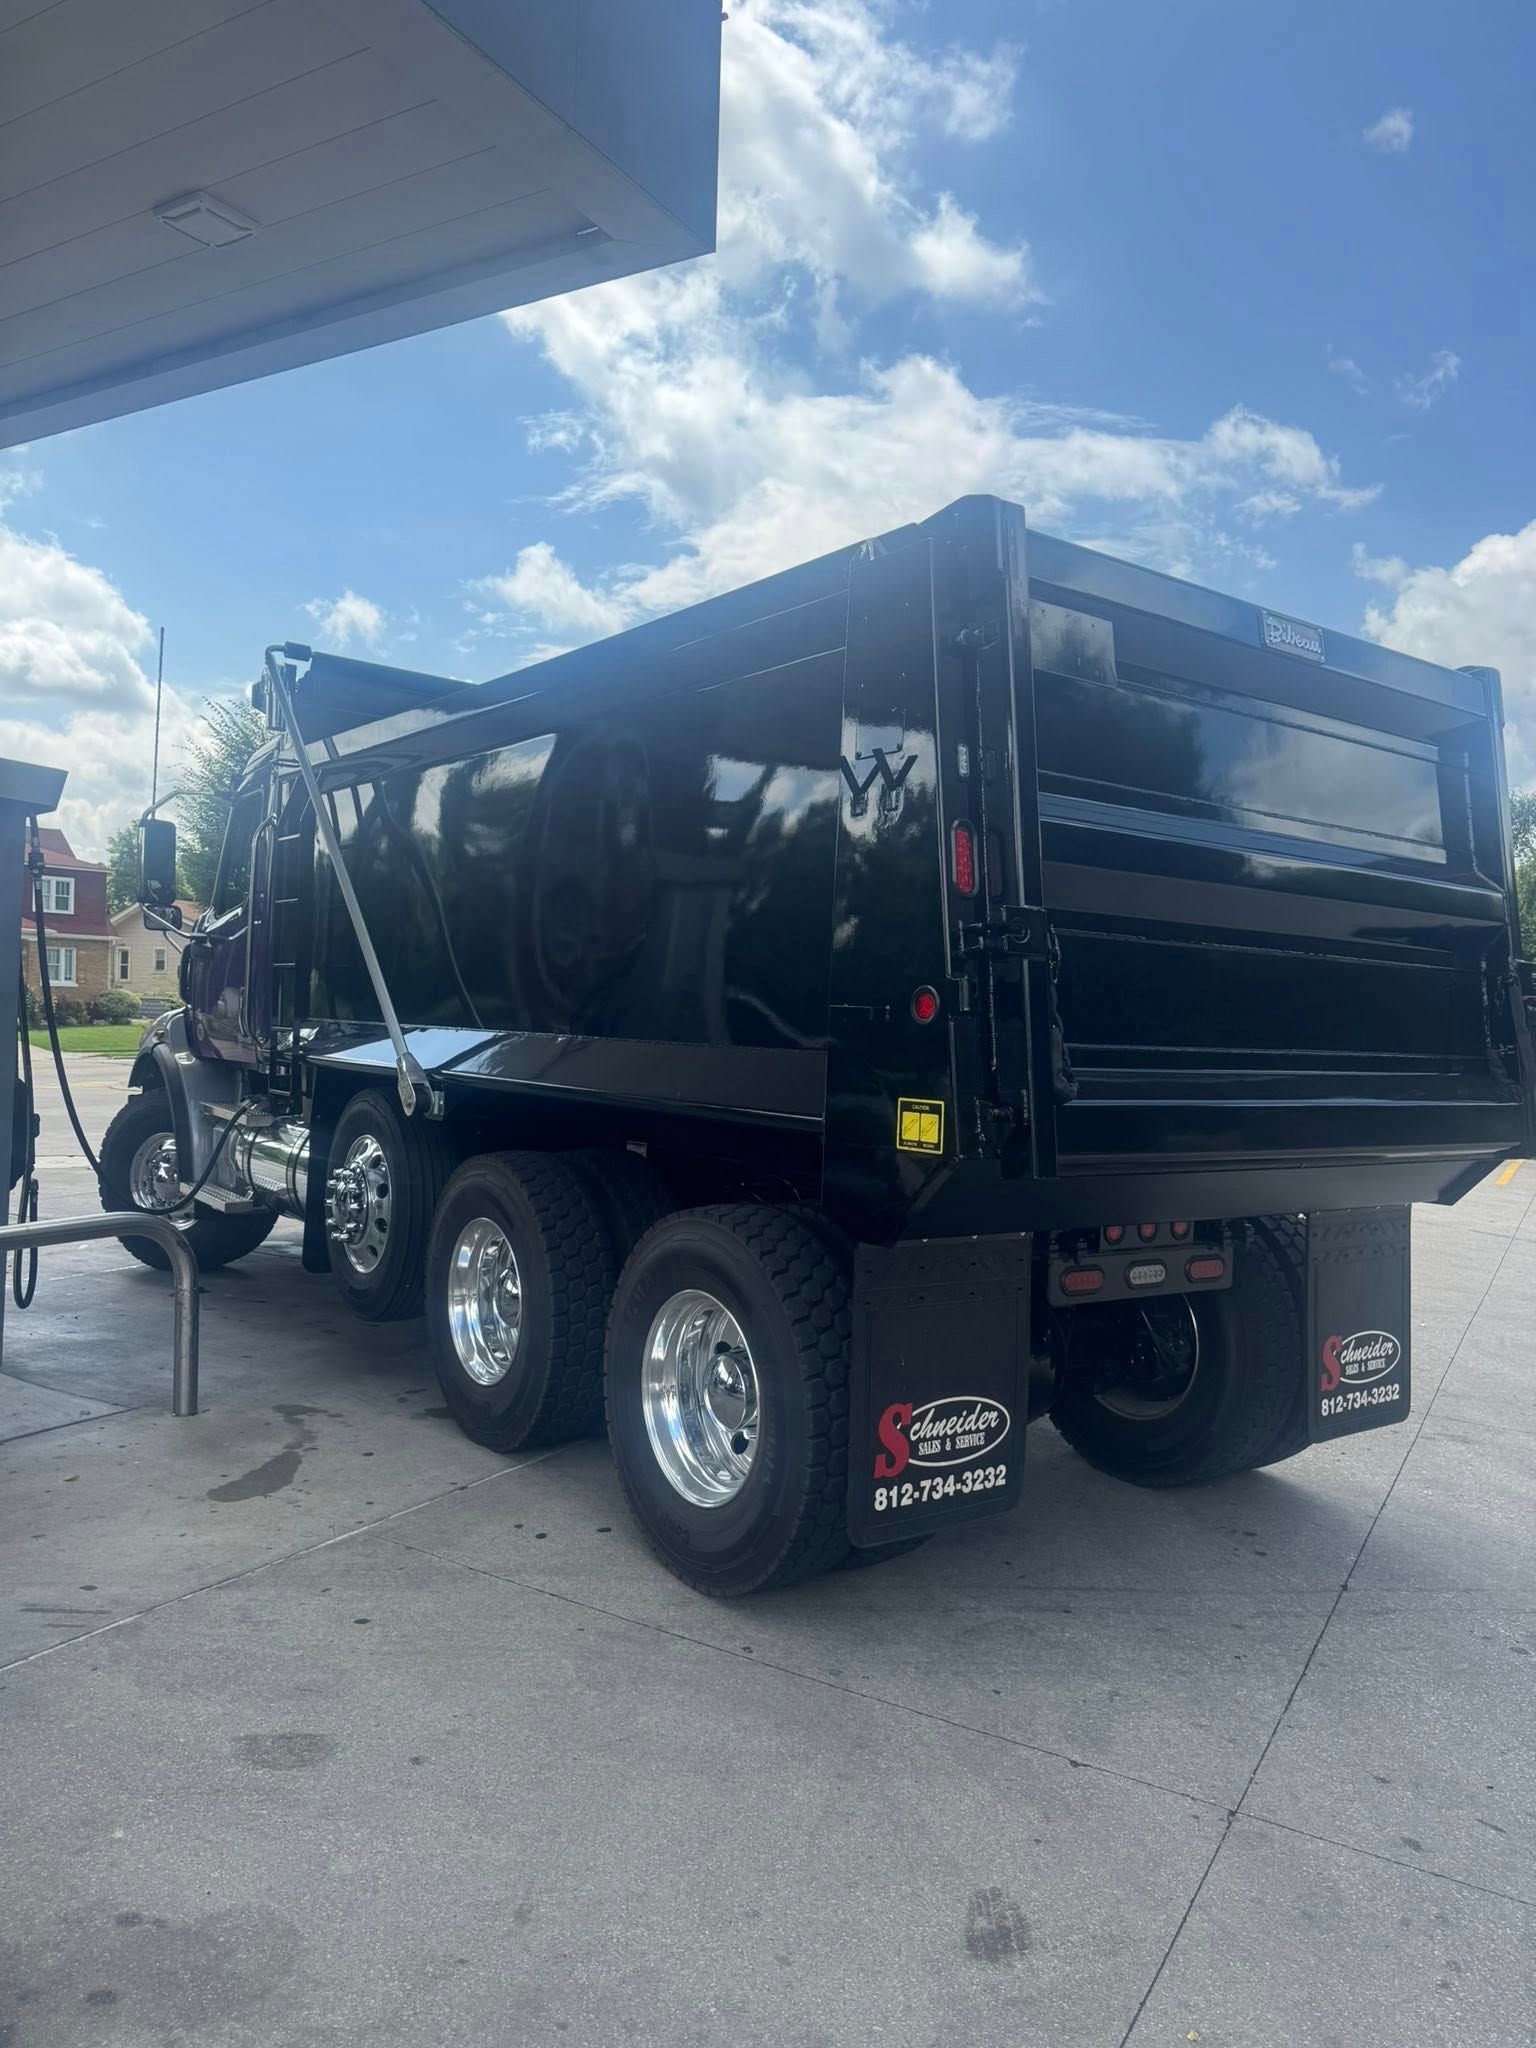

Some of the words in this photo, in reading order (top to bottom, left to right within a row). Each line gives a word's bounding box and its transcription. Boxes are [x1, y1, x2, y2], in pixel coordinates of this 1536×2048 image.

[1320, 1334, 1394, 1392] Schneider
[1321, 1383, 1400, 1416] 812-734-3232
[874, 1402, 999, 1478] Schneider
[918, 1439, 941, 1456] SALES
[945, 1439, 951, 1451] &
[955, 1432, 986, 1449] SERVICE
[874, 1464, 1007, 1511] 812-734-3232
